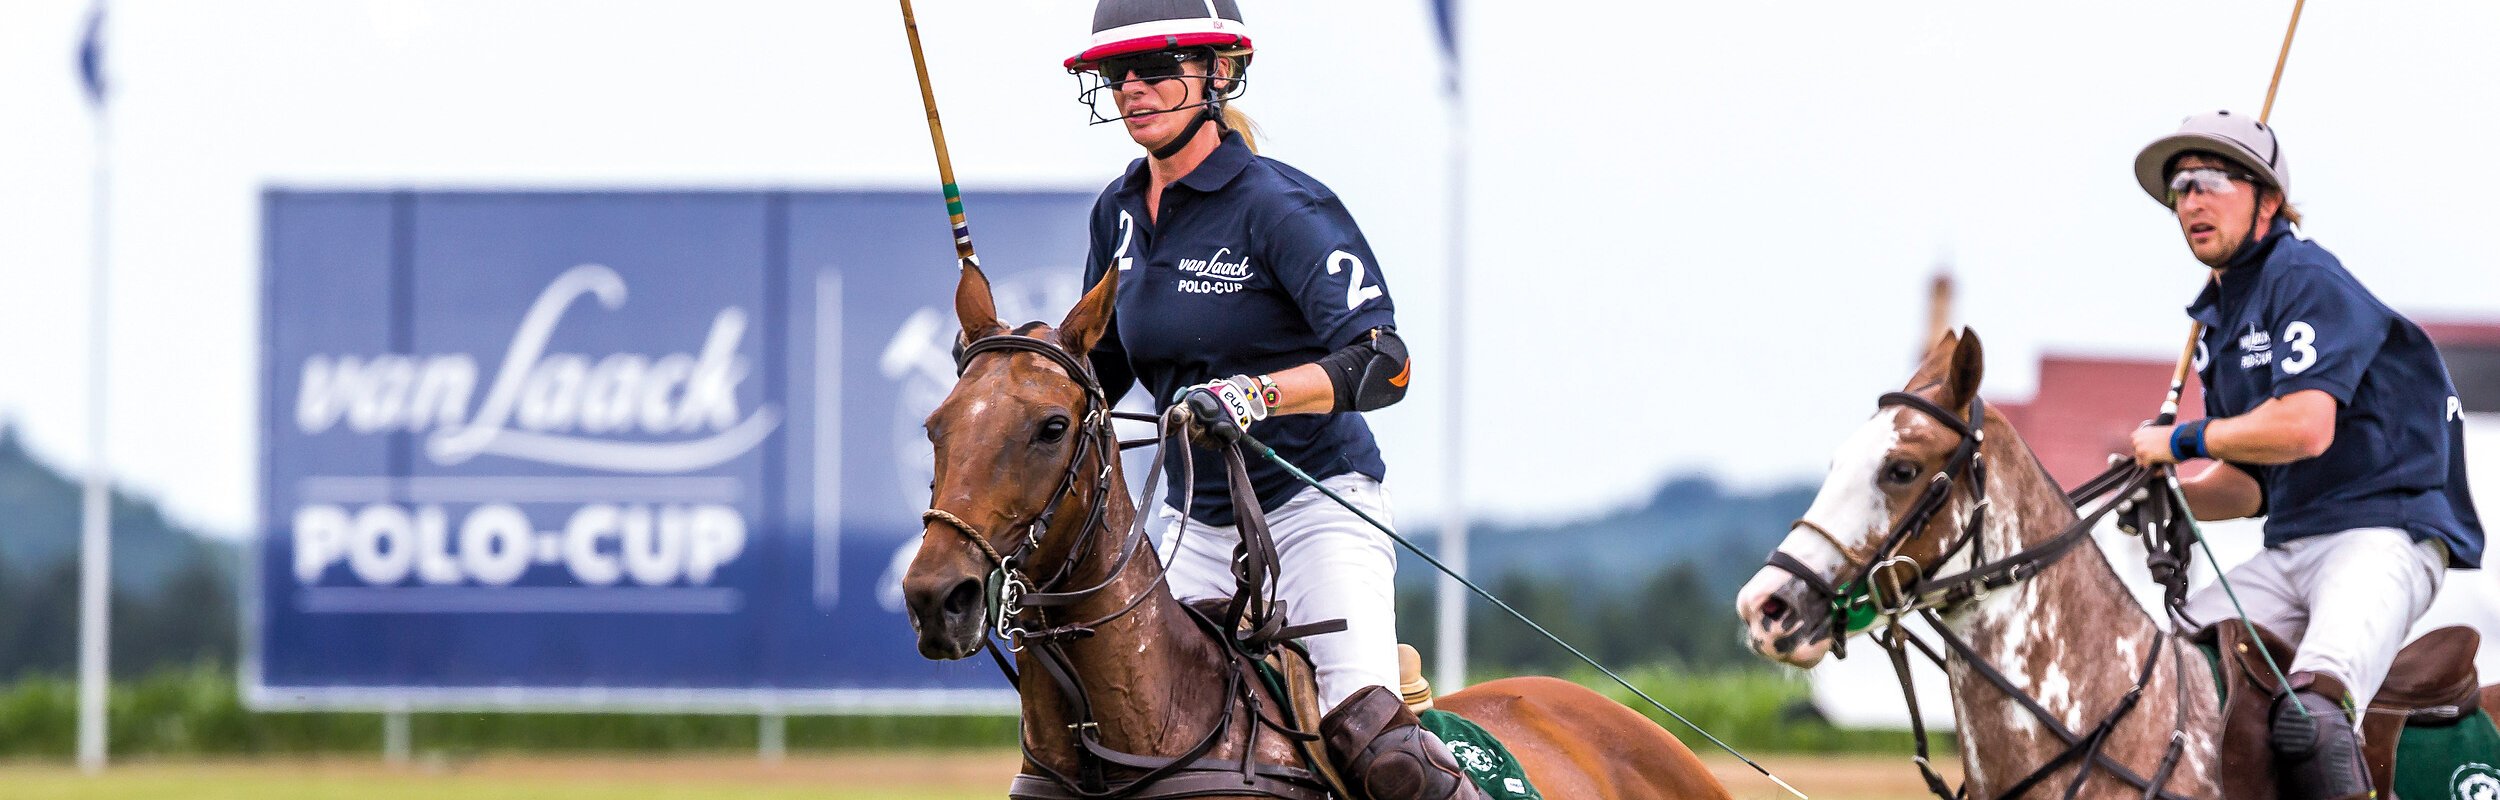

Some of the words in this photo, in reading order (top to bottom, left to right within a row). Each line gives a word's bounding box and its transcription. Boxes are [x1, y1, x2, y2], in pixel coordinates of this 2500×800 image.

[1114, 209, 1134, 271] 2
[1178, 280, 1243, 294] POLO-CUP
[1326, 249, 1383, 310] 2
[2281, 321, 2318, 375] 3
[1224, 391, 1245, 416] ona
[292, 503, 746, 586] POLO-CUP
